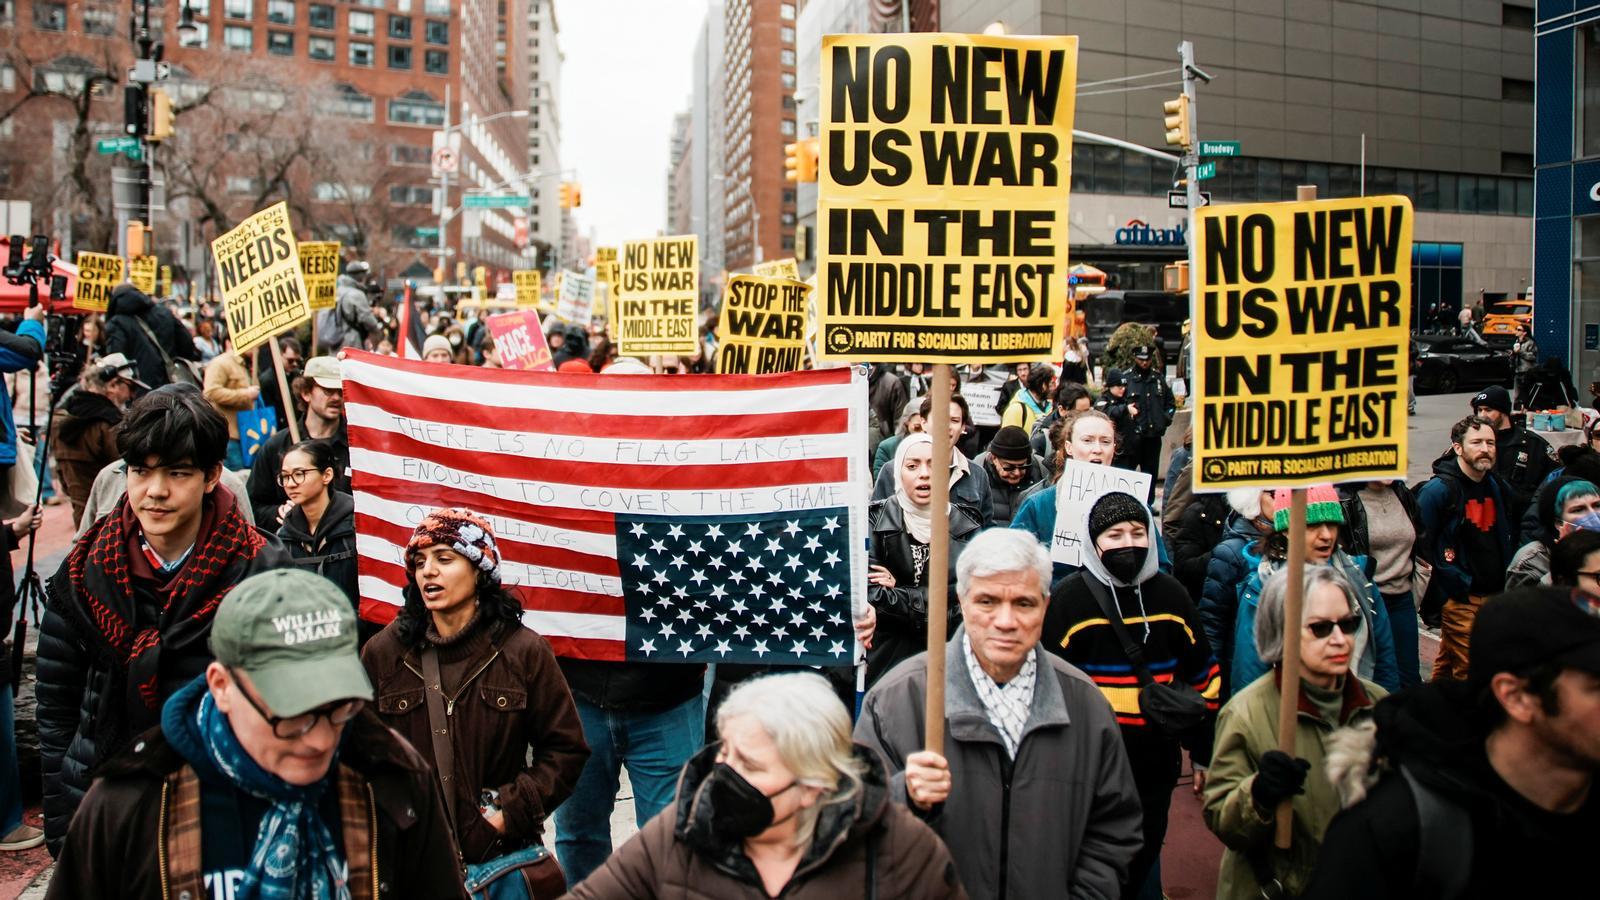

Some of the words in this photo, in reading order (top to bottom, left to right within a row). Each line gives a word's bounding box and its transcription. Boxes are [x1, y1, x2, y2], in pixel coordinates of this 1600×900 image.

[830, 44, 911, 124] NO
[930, 44, 1066, 126] NEW
[828, 128, 912, 187] US
[919, 130, 1060, 187] WAR
[1203, 143, 1234, 156] Broadway
[828, 207, 905, 257] IN
[913, 209, 1056, 257] THE
[1115, 223, 1186, 246] citibank
[1204, 213, 1276, 286] NO
[1293, 205, 1404, 282] NEW
[80, 255, 122, 273] HANDS
[220, 227, 291, 292] NEEDS
[624, 243, 648, 270] NO
[653, 240, 694, 269] NEW
[77, 281, 113, 301] IRAN
[228, 287, 255, 309] NOT
[258, 267, 295, 290] WAR
[623, 272, 649, 292] US
[651, 271, 694, 291] WAR
[729, 280, 778, 310] STOP
[782, 285, 808, 312] THE
[827, 261, 961, 318] MIDDLE
[971, 263, 1055, 318] EAST
[230, 300, 253, 333] W/
[258, 278, 301, 318] IRAN
[623, 299, 646, 316] IN
[649, 298, 694, 316] THE
[1204, 287, 1279, 340] US
[1284, 280, 1401, 335] WAR
[623, 318, 663, 338] MIDDLE
[667, 318, 694, 338] EAST
[728, 309, 804, 340] WAR
[492, 325, 536, 362] PEACE
[855, 331, 891, 349] PARTY
[893, 331, 916, 349] FOR
[917, 332, 979, 350] SOCIALISM
[980, 332, 990, 350] &
[991, 332, 1052, 350] LIBERATION
[721, 343, 752, 374] ON
[1204, 354, 1272, 398] IN
[1280, 344, 1399, 393] THE
[1203, 397, 1321, 450] MIDDLE
[1328, 390, 1397, 443] EAST
[392, 416, 478, 450] THERE
[491, 432, 526, 453] IS
[544, 438, 585, 458] NO
[616, 441, 697, 463] FLAG
[720, 438, 819, 462] LARGE
[1228, 460, 1260, 476] PARTY
[1261, 460, 1282, 475] FOR
[1283, 455, 1333, 474] SOCIALISM
[1334, 454, 1342, 469] &
[1343, 450, 1397, 468] LIBERATION
[402, 458, 498, 496] ENOUGH
[516, 482, 556, 503] TO
[580, 488, 681, 513] COVER
[691, 491, 756, 512] THE
[773, 485, 845, 513] SHAME
[527, 565, 620, 596] PEOPLE
[272, 608, 342, 633] WILLIAM
[296, 622, 341, 644] MARY
